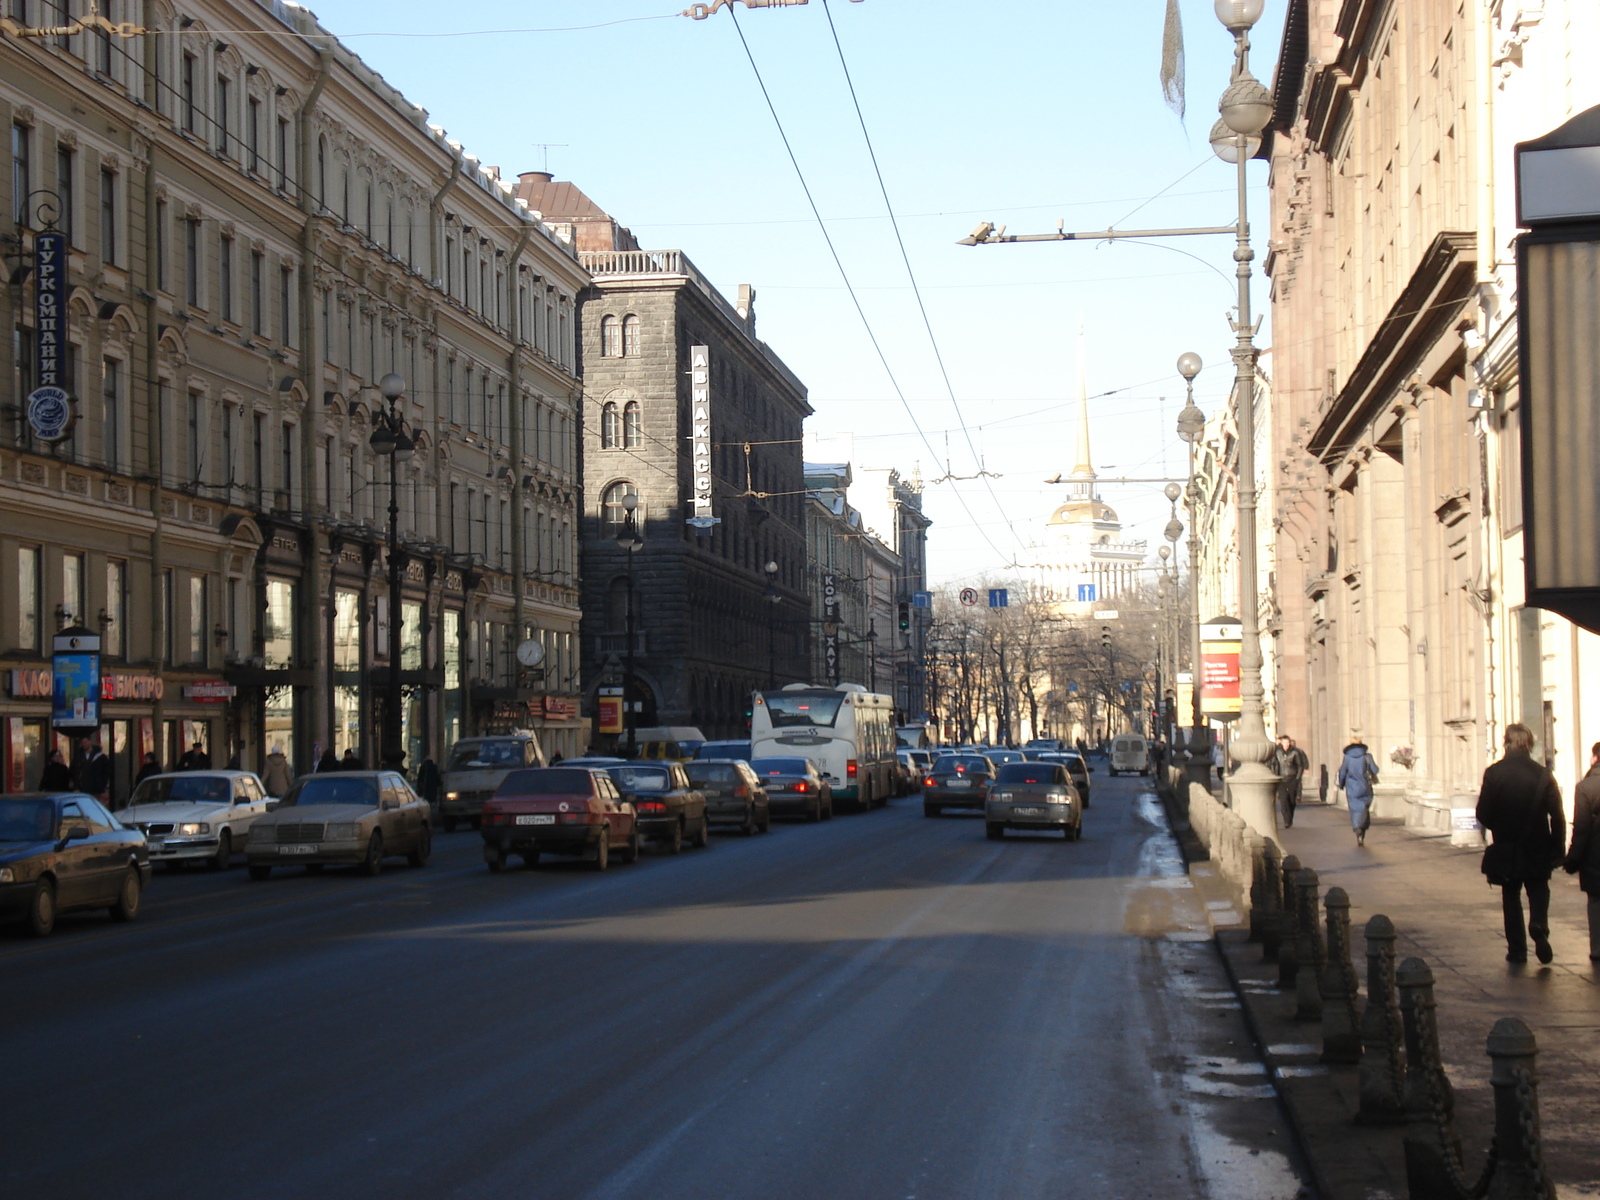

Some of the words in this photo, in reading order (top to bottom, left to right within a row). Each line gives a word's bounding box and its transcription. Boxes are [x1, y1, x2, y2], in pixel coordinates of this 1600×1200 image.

[39, 236, 57, 385] ТУРКОМПАНИЯ
[33, 389, 64, 400] WORLD
[694, 353, 711, 508] АВИАКАССЫ
[272, 536, 298, 551] ETRO
[340, 550, 362, 564] ETRO
[825, 575, 835, 616] КОФЕ
[826, 637, 836, 677] ХАУЗ
[116, 674, 164, 700] БИСТРО
